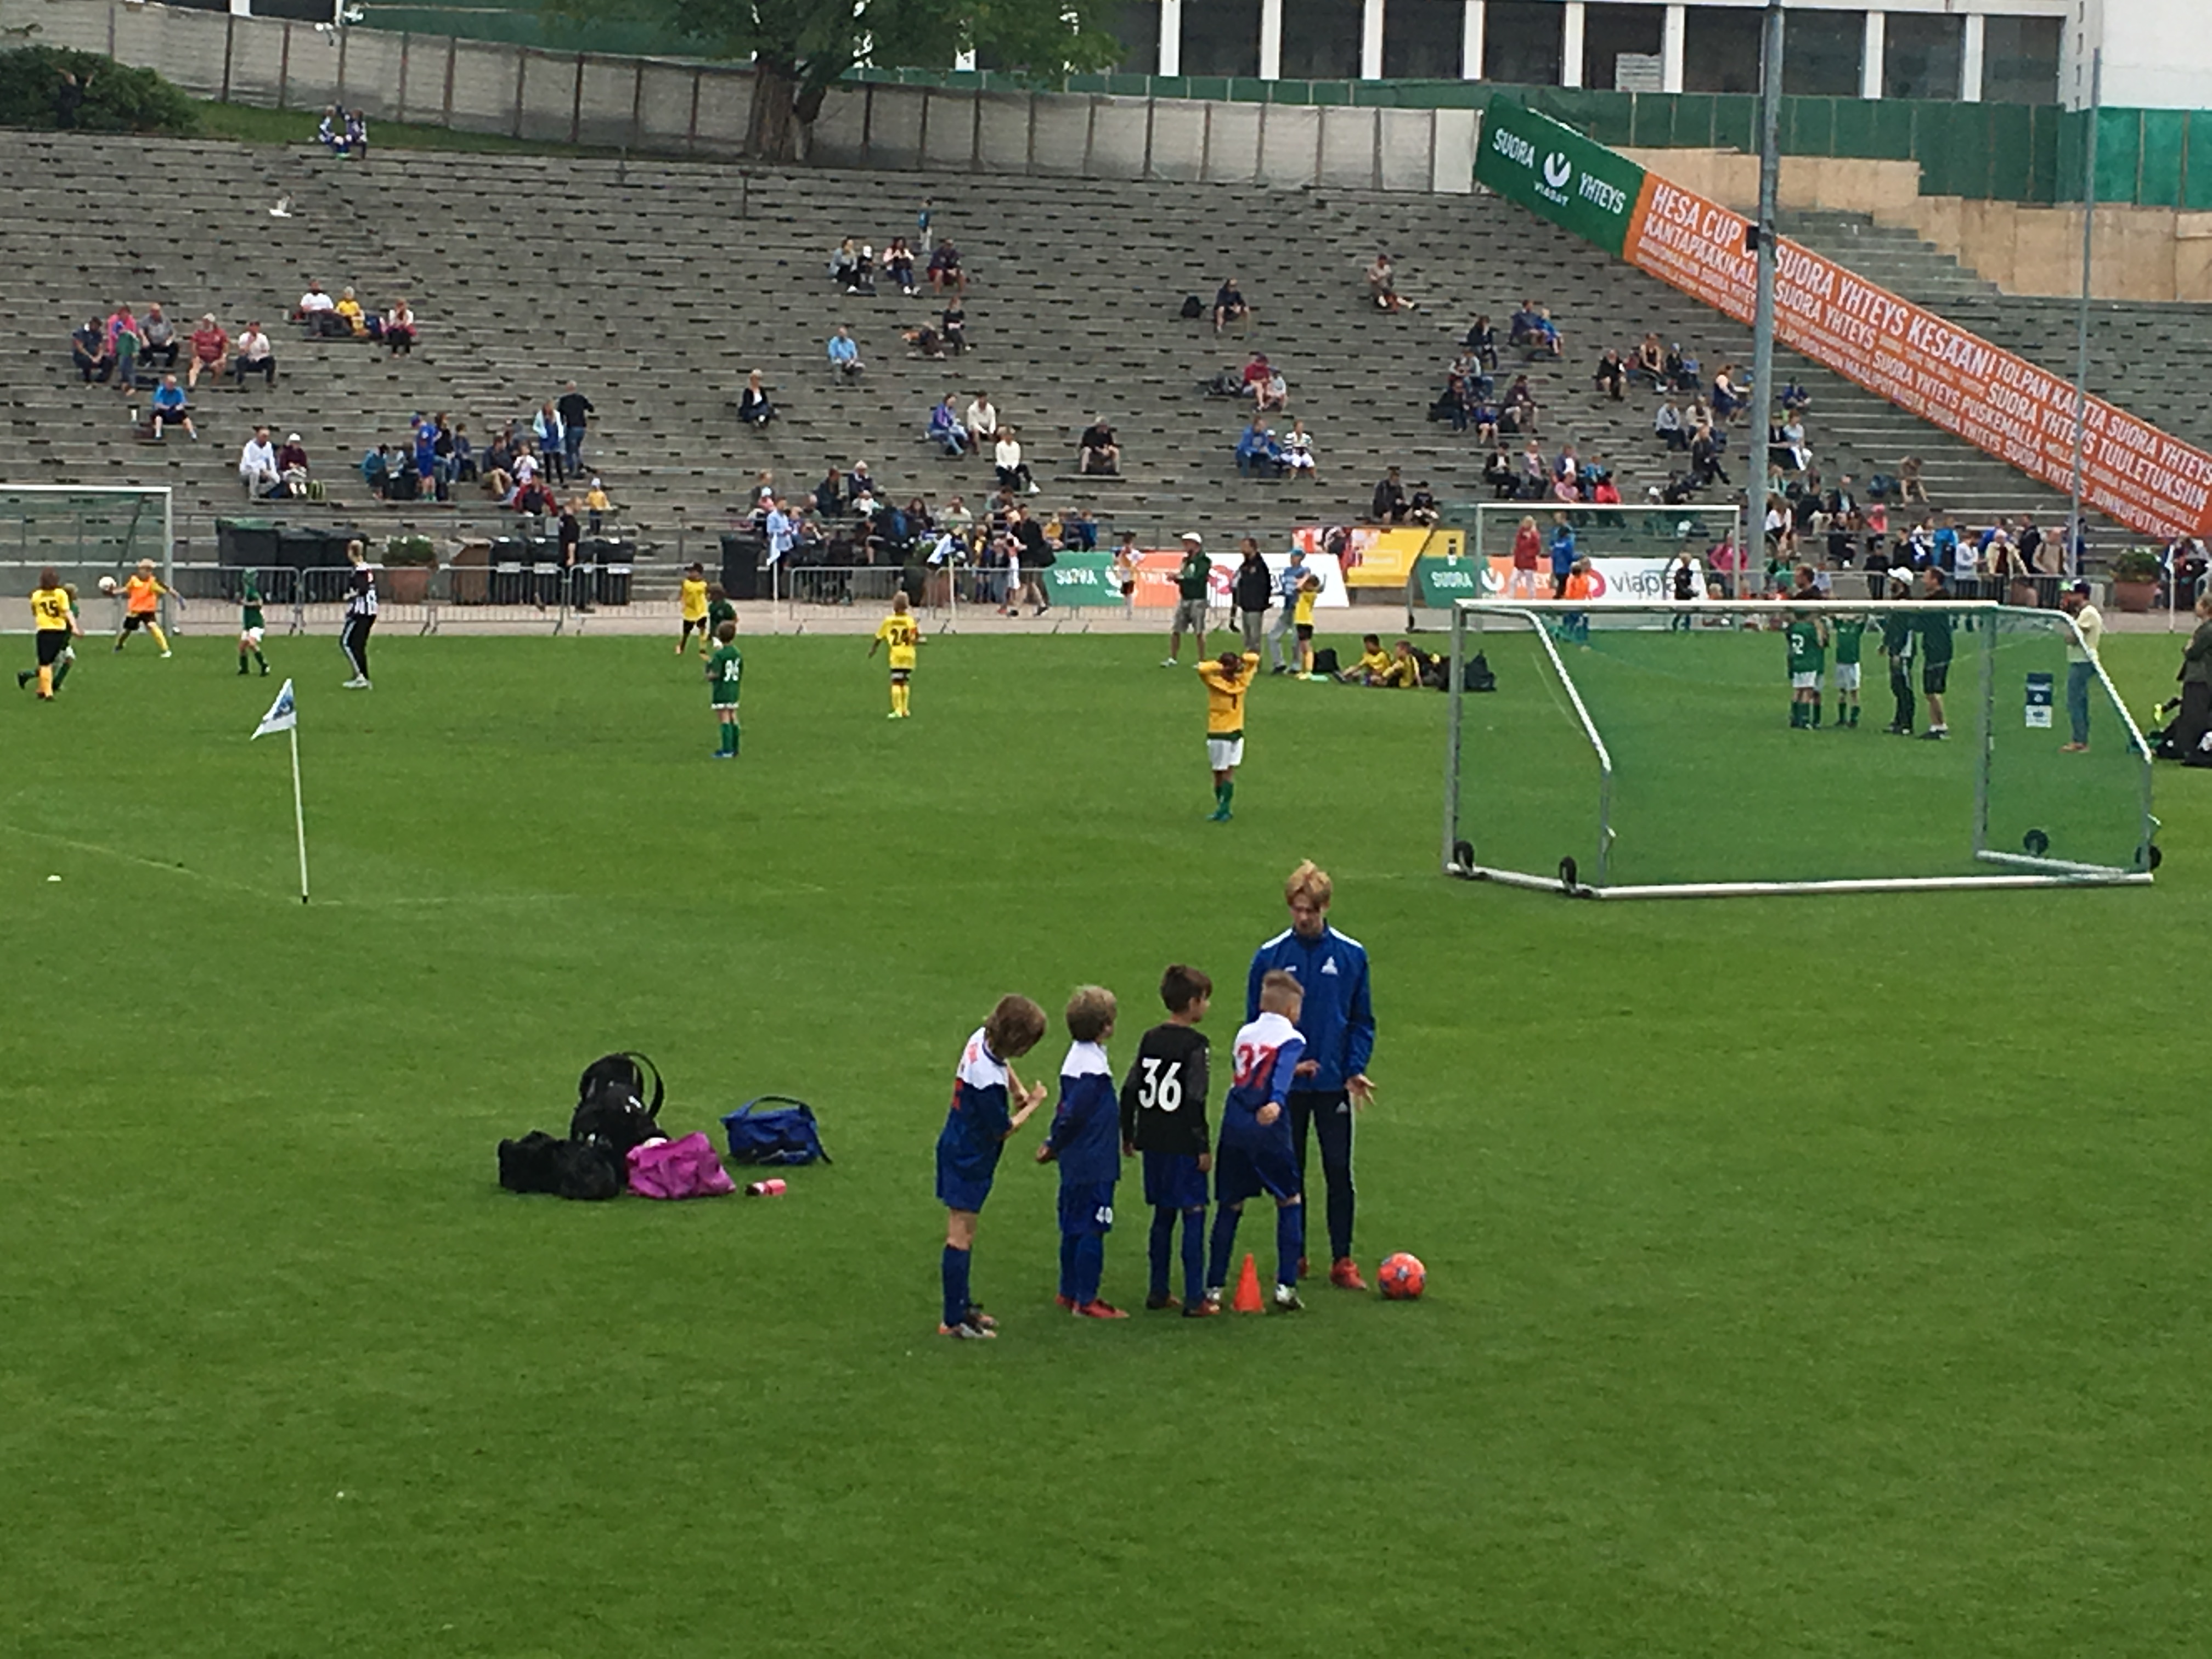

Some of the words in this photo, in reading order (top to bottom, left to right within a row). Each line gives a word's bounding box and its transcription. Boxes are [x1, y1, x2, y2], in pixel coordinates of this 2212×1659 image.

[1494, 128, 1534, 168] SUORA
[1580, 173, 1626, 215] YHTEYS
[1652, 183, 1700, 231] HESA
[1703, 210, 1741, 246] CUP
[1776, 245, 1834, 299] SUORA
[1838, 278, 1909, 336] YHTEYS
[1774, 279, 1821, 321] SUORA
[1825, 307, 1876, 350] YHTEYS
[1987, 381, 2037, 425] SUORA
[1997, 358, 2051, 401] TOLPAN
[2108, 415, 2157, 457] SUORA
[2046, 462, 2087, 496] YHTES
[40, 600, 60, 618] 15
[890, 628, 910, 646] 24
[1138, 1057, 1182, 1111] 36
[1233, 1043, 1279, 1088] 37
